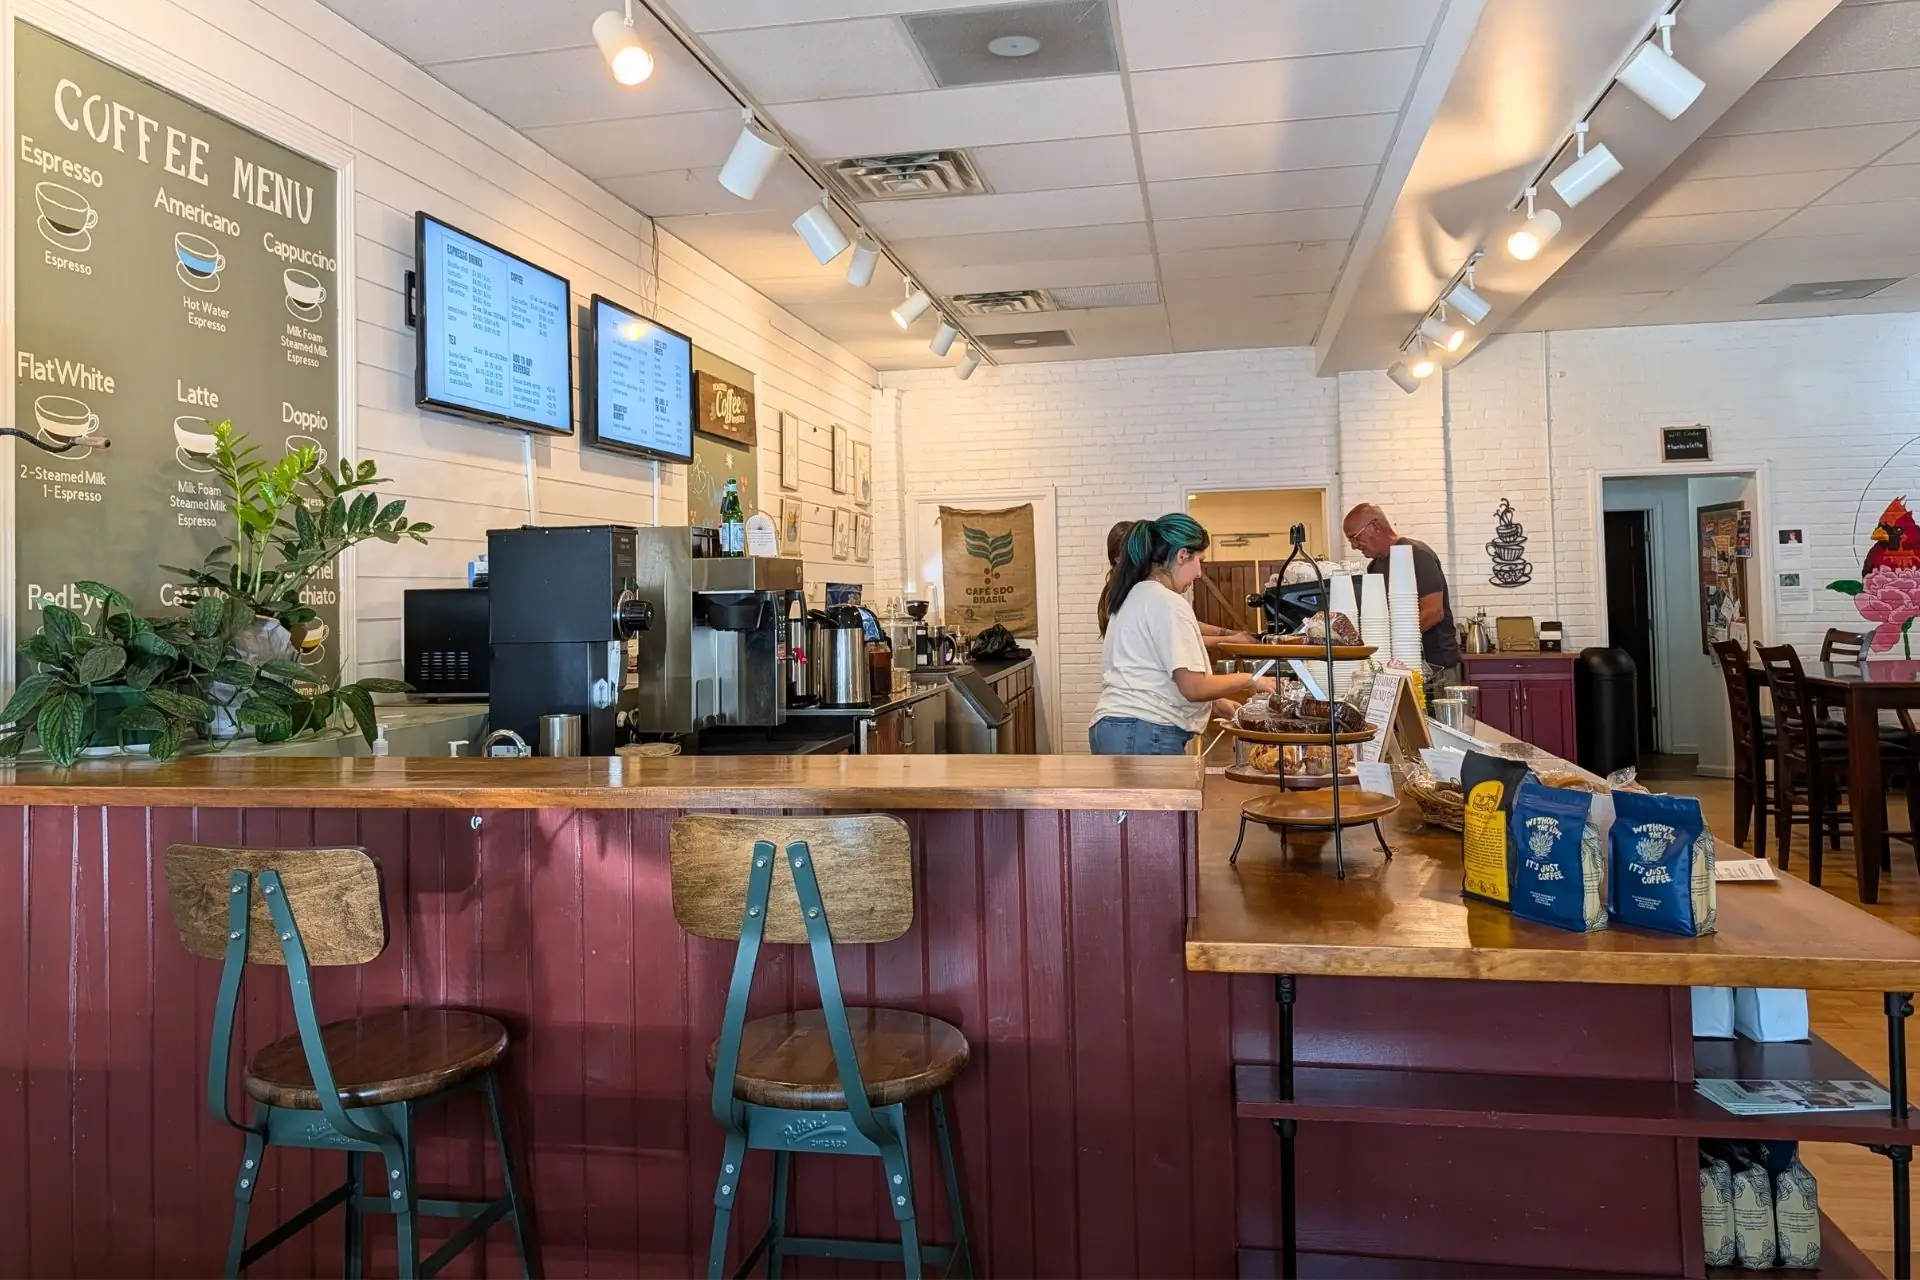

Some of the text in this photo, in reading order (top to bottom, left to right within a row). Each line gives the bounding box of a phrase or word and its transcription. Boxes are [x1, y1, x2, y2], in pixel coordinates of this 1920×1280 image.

[20, 134, 104, 188] Espresso
[54, 78, 314, 225] COFFEE MENU
[154, 187, 241, 237] Americano
[263, 231, 337, 272] Cappuccino
[44, 250, 93, 276] Espresso
[183, 296, 231, 319] Hot Water
[187, 312, 227, 333] Espresso
[286, 323, 323, 343] Milk Foam
[280, 335, 329, 358] Steamed Milk
[287, 350, 320, 368] Espresso
[176, 379, 219, 409] Latte
[715, 388, 741, 424] Coffee
[282, 401, 328, 432] Doppio
[85, 470, 107, 486] Milk
[178, 480, 222, 496] Milk Foam
[170, 494, 227, 512] Steamed Milk
[178, 513, 217, 529] Espresso
[972, 595, 1007, 604] BRASIL
[1525, 816, 1559, 829] WITHOUT
[1632, 823, 1675, 834] WITHOUT
[1525, 859, 1559, 873] IT'S JUST
[1628, 862, 1667, 877] IT'S JUST
